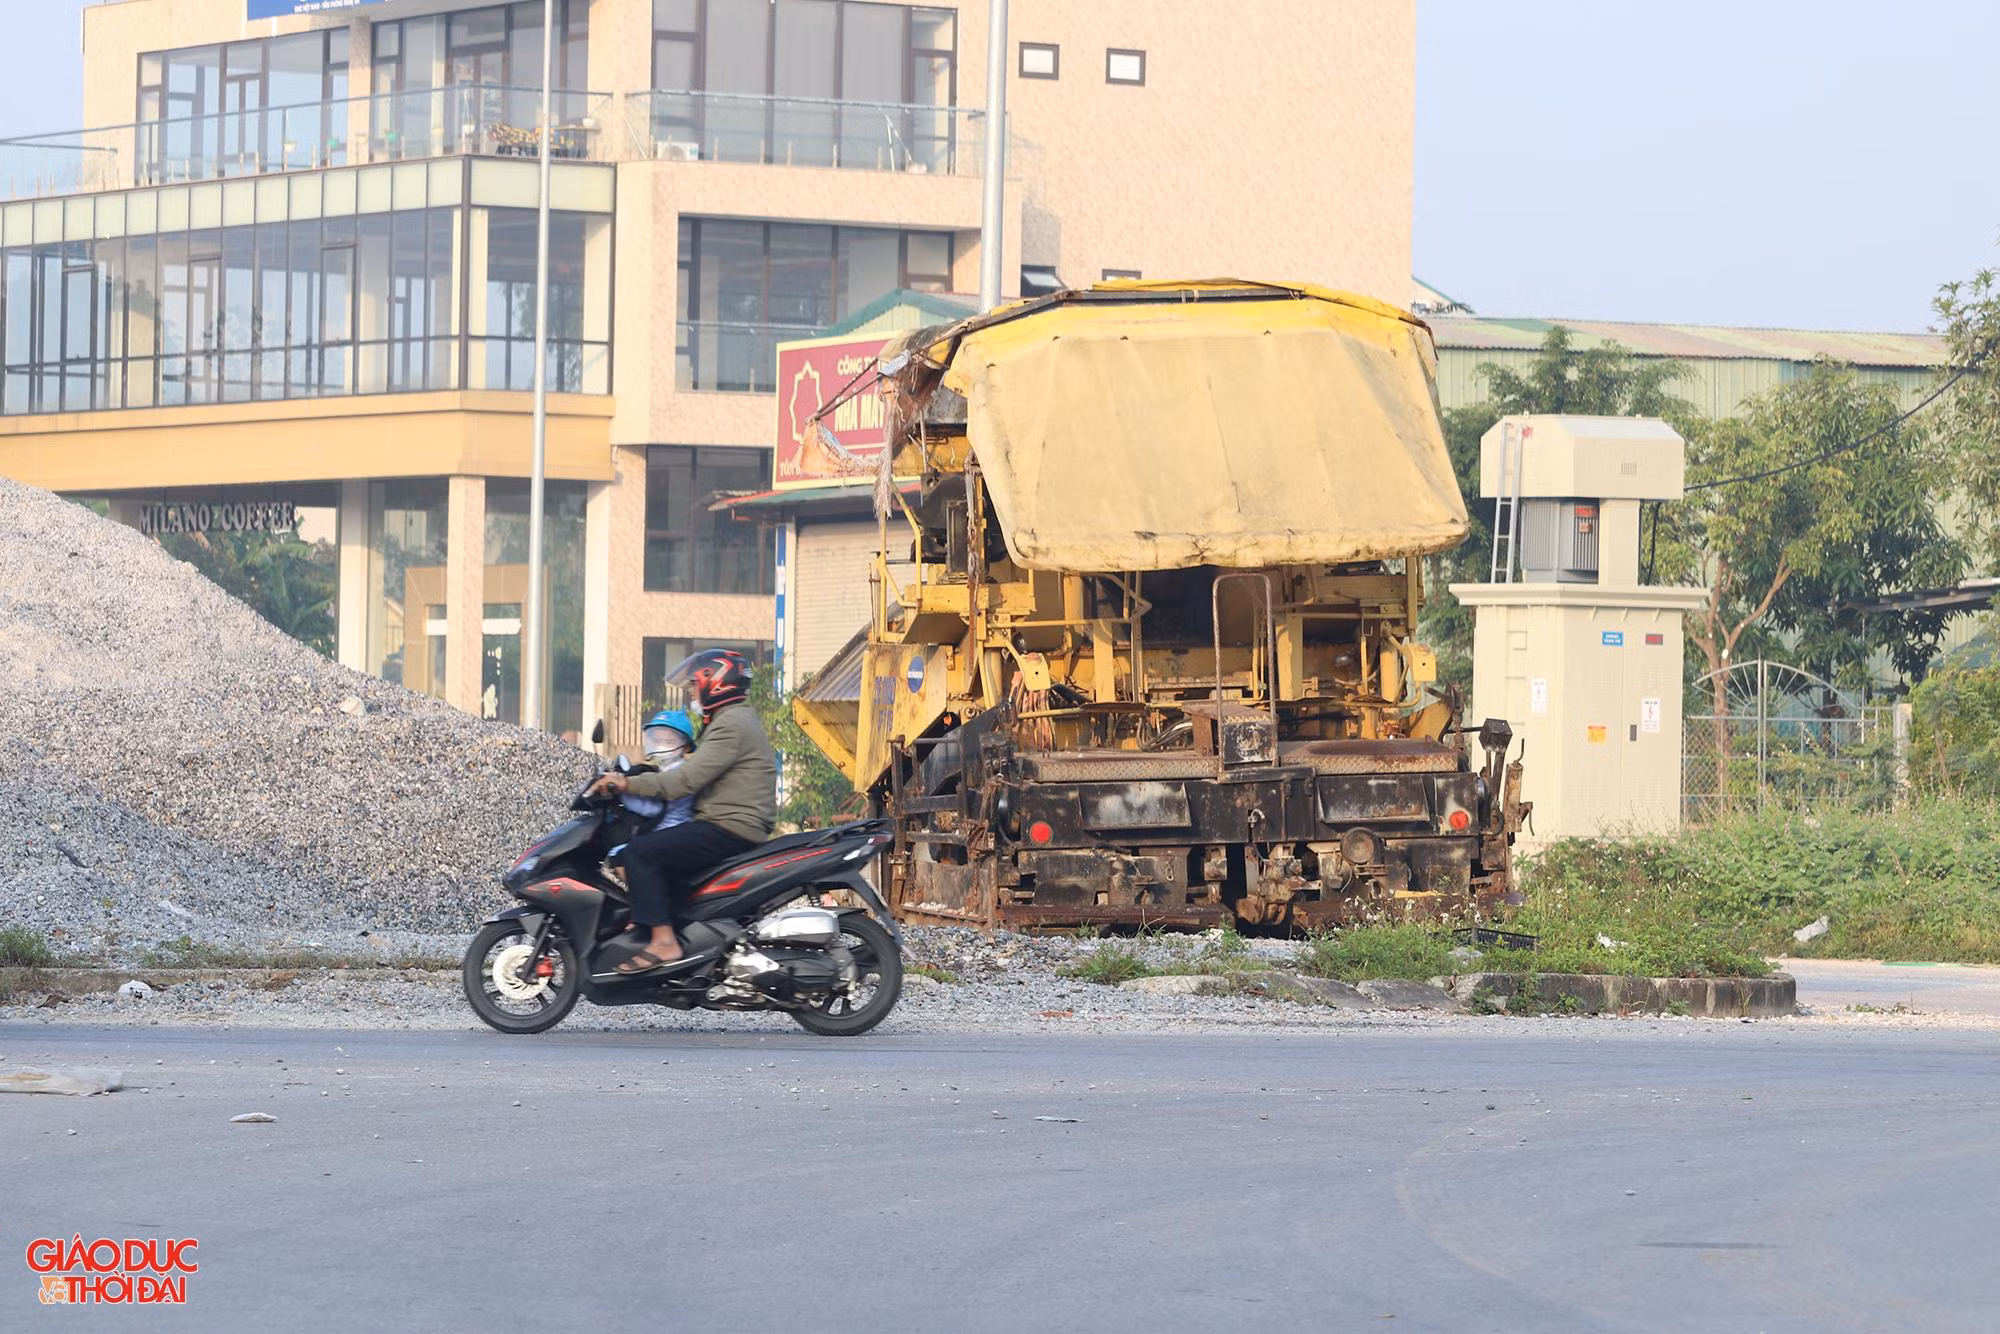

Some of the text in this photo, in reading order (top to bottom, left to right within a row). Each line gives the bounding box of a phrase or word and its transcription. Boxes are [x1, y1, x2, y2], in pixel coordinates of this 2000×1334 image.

[837, 354, 863, 376] CÔNG
[139, 500, 293, 533] MILANO COFFEE
